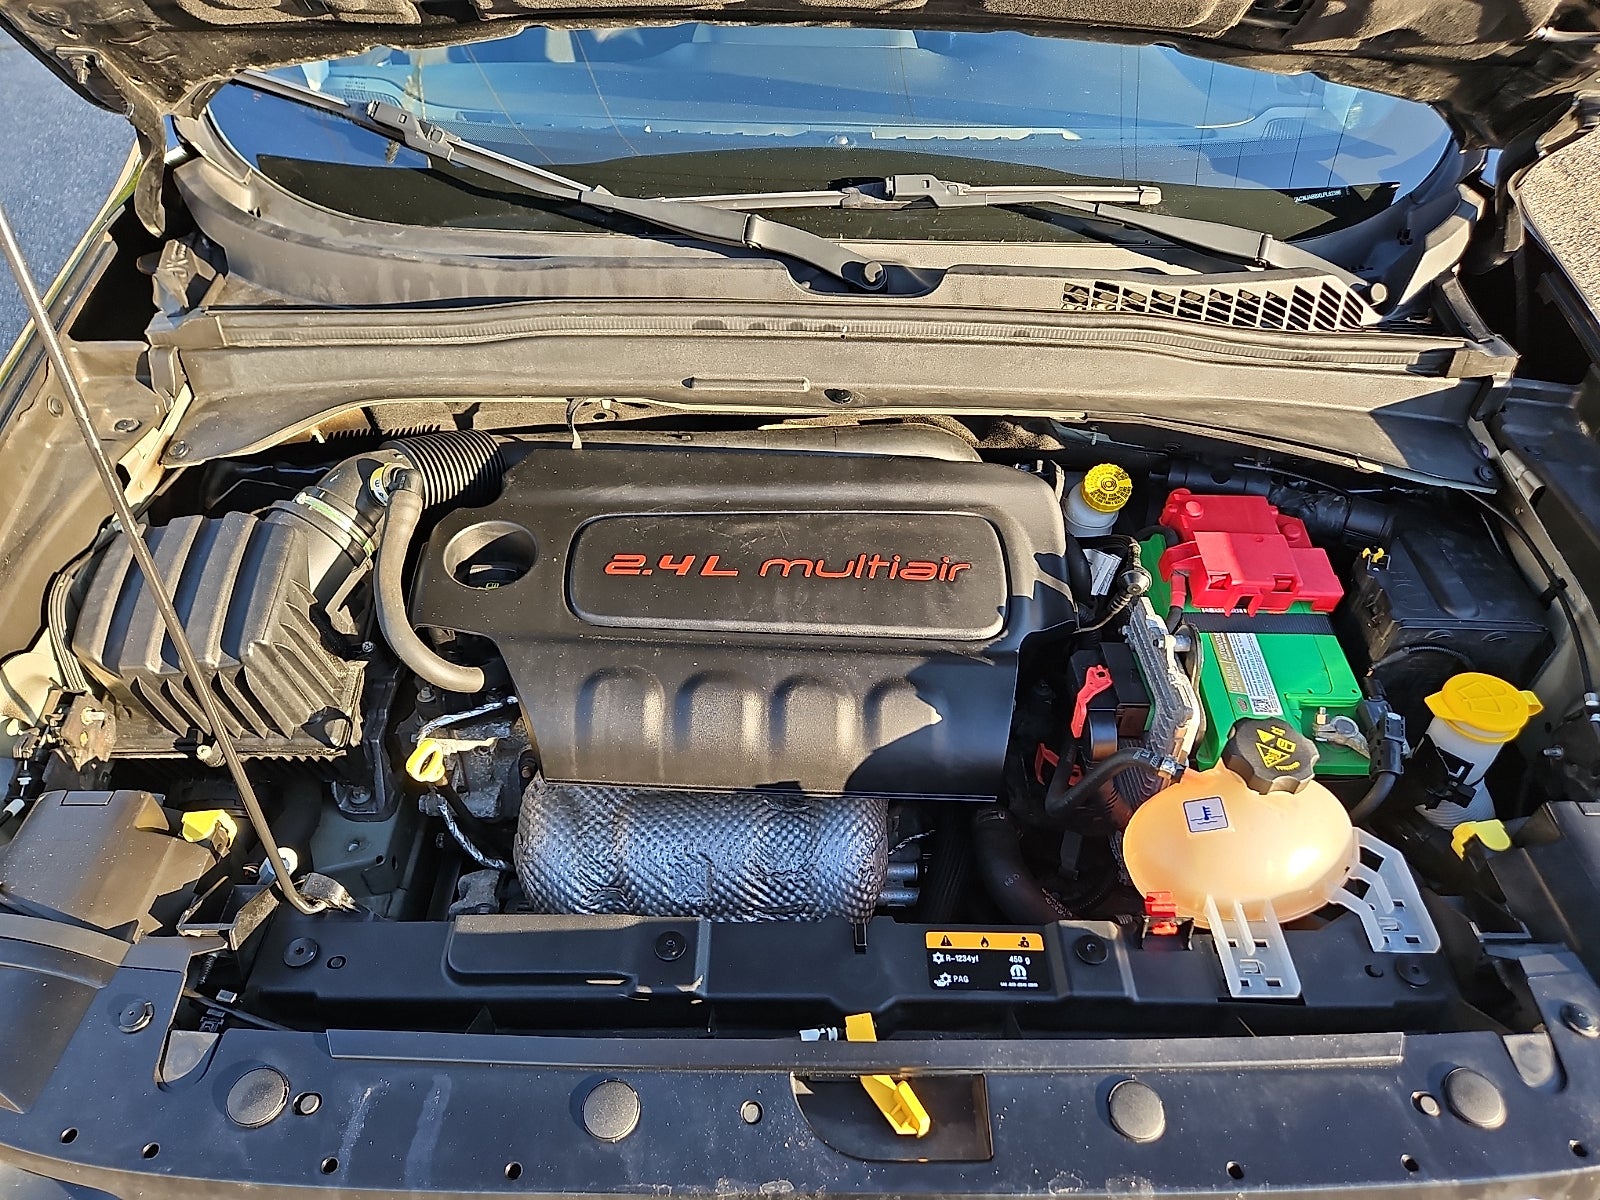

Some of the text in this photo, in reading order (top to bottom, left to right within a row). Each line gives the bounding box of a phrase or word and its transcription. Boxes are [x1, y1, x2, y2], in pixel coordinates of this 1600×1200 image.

[604, 553, 972, 582] 2.4L multiair
[1009, 955, 1031, 966] 450 g
[953, 975, 970, 984] PAG
